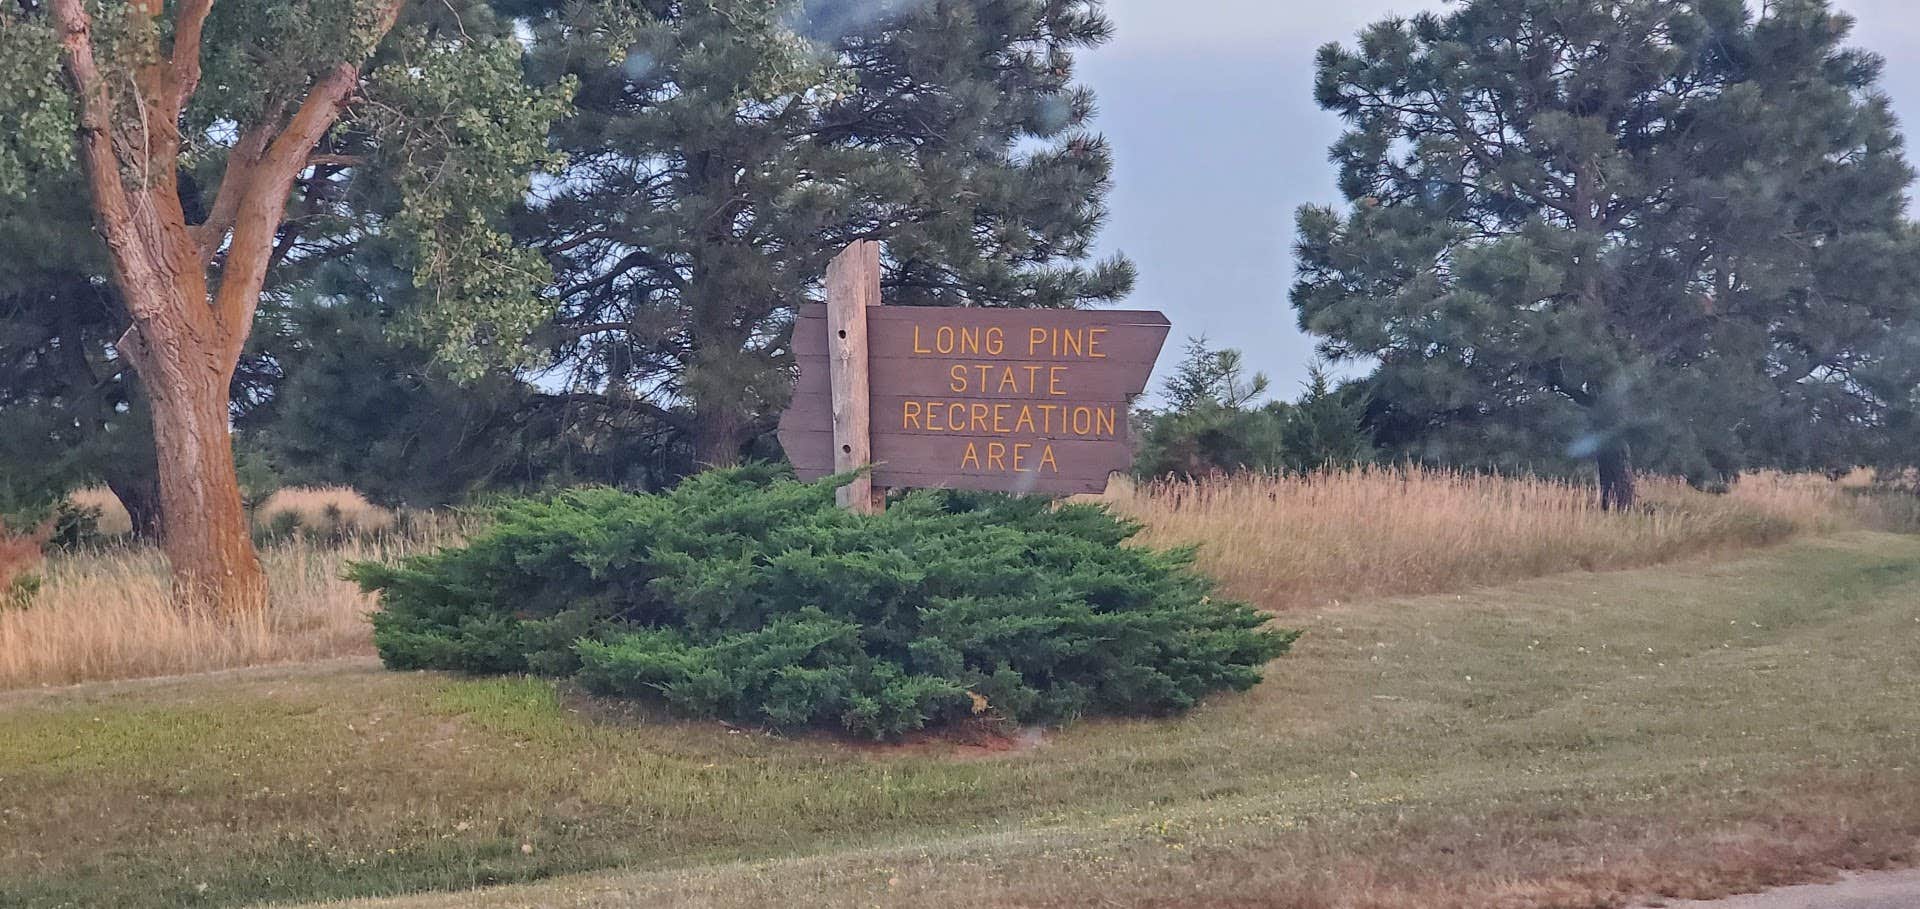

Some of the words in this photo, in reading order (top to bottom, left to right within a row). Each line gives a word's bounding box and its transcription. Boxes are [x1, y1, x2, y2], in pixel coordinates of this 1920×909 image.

[912, 324, 1005, 356] LONG
[1028, 326, 1107, 358] PINE
[949, 364, 1067, 396] STATE
[902, 400, 1116, 436] RECREATION
[962, 440, 1057, 472] AREA
